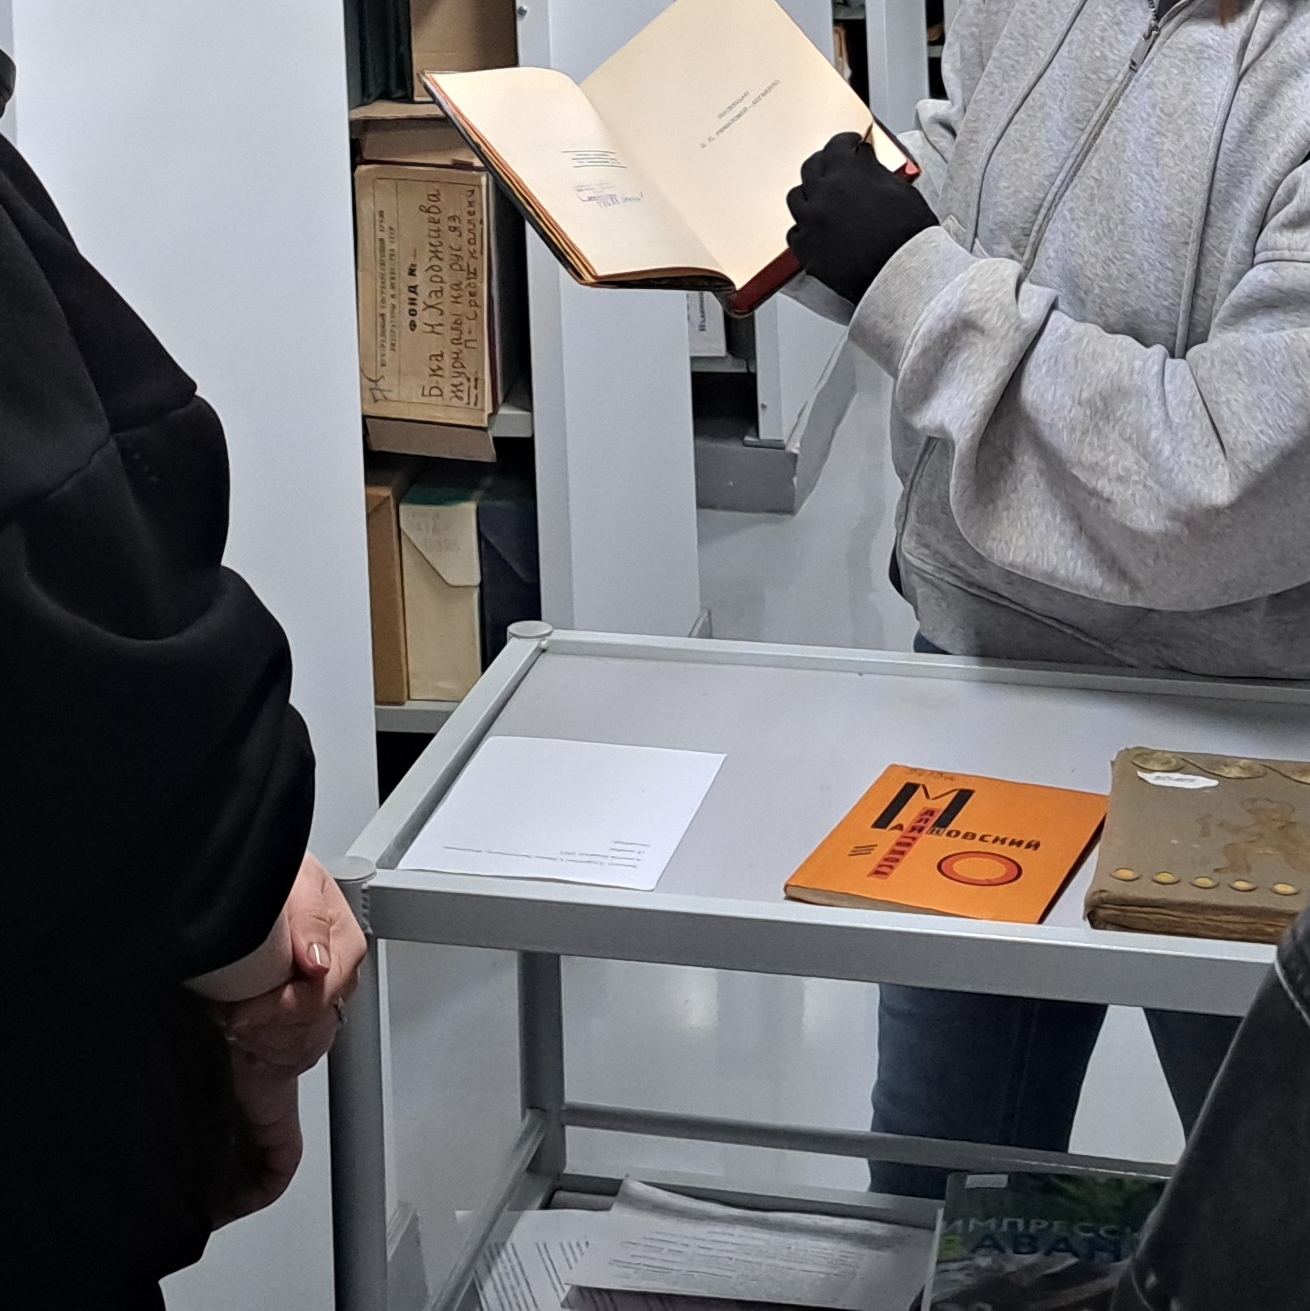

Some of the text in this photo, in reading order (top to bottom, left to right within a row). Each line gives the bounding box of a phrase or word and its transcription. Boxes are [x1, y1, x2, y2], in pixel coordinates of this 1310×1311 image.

[418, 189, 449, 317] Харджиева
[407, 284, 418, 332] ФОНД
[448, 281, 462, 305] на
[941, 1217, 1139, 1239] ИМПРЕСС
